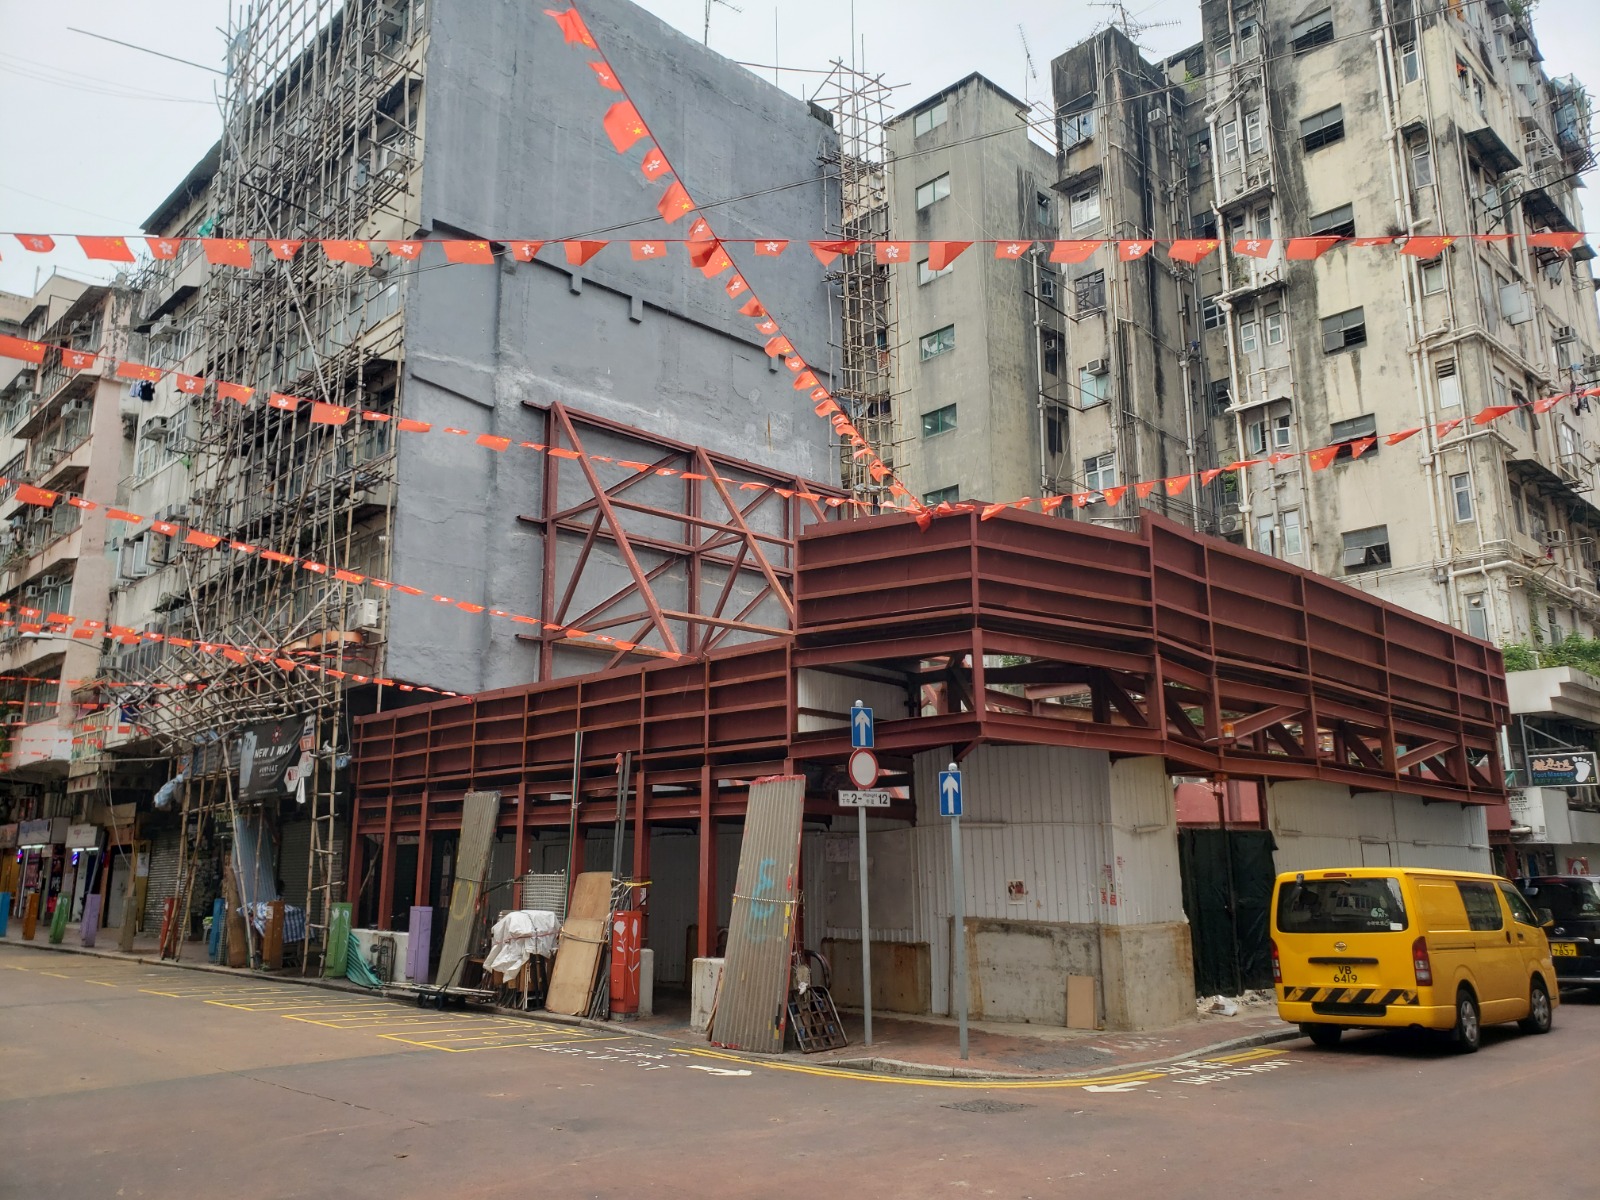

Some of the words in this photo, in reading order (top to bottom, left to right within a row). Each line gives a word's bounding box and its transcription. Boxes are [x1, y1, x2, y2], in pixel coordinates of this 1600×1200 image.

[878, 793, 888, 804] 12
[1553, 948, 1574, 956] 7837
[1338, 965, 1352, 975] VB
[1333, 974, 1358, 983] 6419
